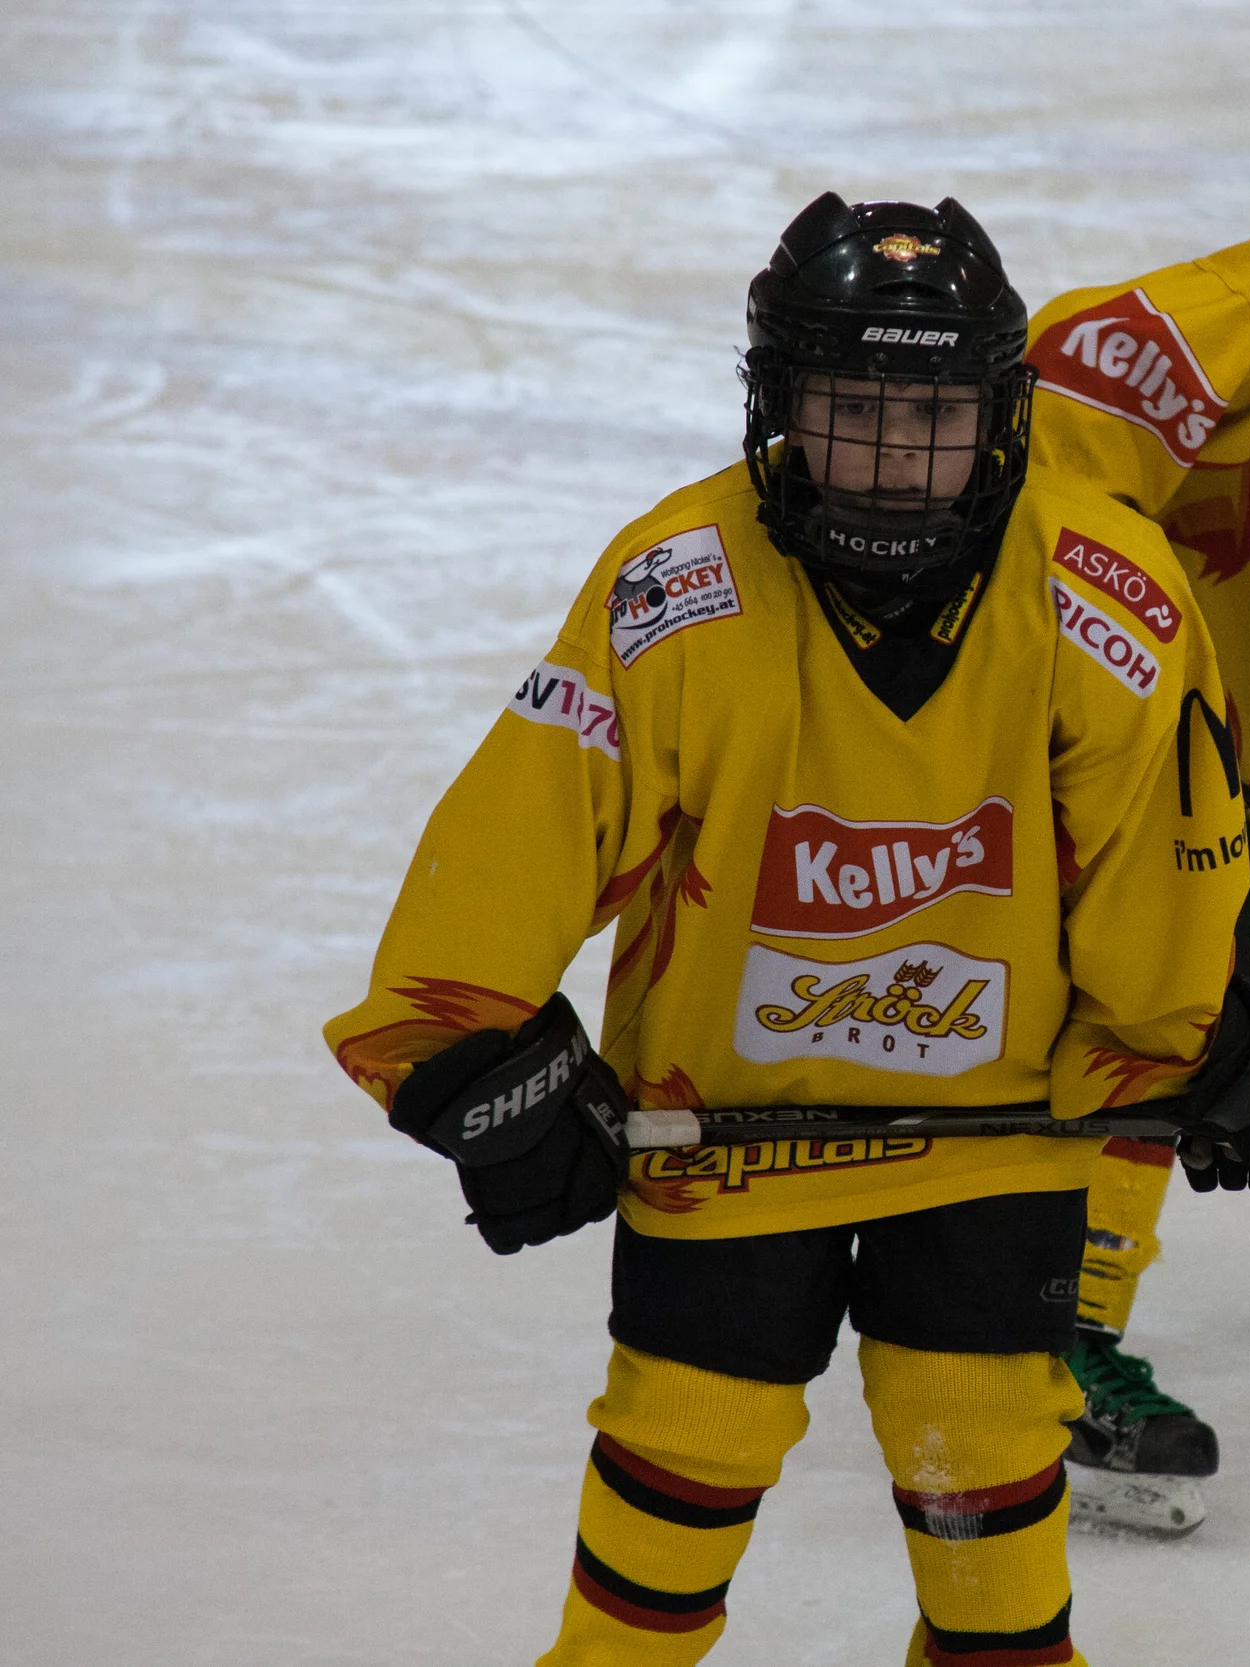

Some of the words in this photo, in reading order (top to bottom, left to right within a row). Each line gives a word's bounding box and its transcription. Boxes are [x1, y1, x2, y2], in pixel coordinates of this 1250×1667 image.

[862, 326, 960, 348] BAUER
[1061, 317, 1216, 449] Kelly's
[829, 528, 938, 556] HOCKEY
[1064, 544, 1147, 602] ASKÖ
[620, 598, 737, 661] www.prohockey.at
[795, 825, 985, 909] Kelly's
[1174, 839, 1217, 872] i'm
[755, 972, 991, 1040] Ströck
[811, 1027, 930, 1059] BROT
